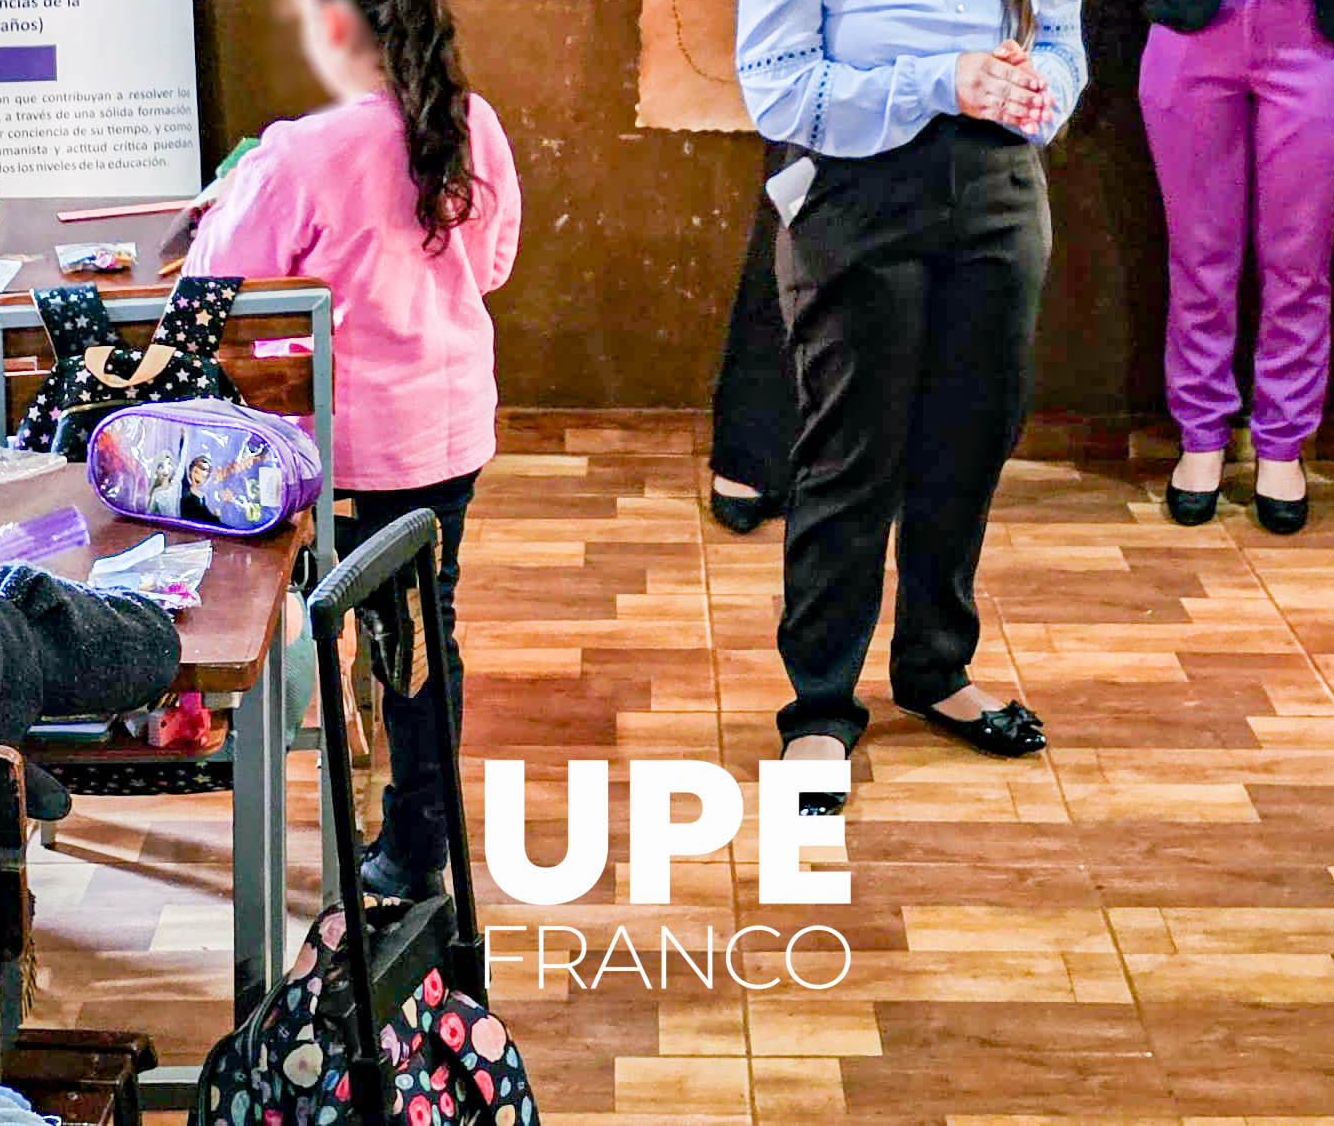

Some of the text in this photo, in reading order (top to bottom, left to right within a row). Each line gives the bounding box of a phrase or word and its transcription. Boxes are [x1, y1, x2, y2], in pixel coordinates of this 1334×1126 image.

[0, 17, 44, 35] años)
[15, 95, 37, 106] que
[42, 91, 112, 106] contribuyan
[129, 89, 173, 100] resolver
[16, 110, 52, 122] través
[56, 110, 69, 120] de
[74, 111, 96, 120] una
[100, 105, 134, 118] sólida
[138, 104, 192, 117] formación
[8, 122, 193, 139] conciencia de su tiempo, como
[67, 142, 107, 154] actitud
[113, 140, 148, 152] crítica
[153, 139, 193, 151] puedan
[18, 162, 35, 173] los
[36, 160, 77, 172] niveles
[79, 158, 94, 170] de
[96, 158, 105, 169] la
[108, 155, 170, 170] educación.
